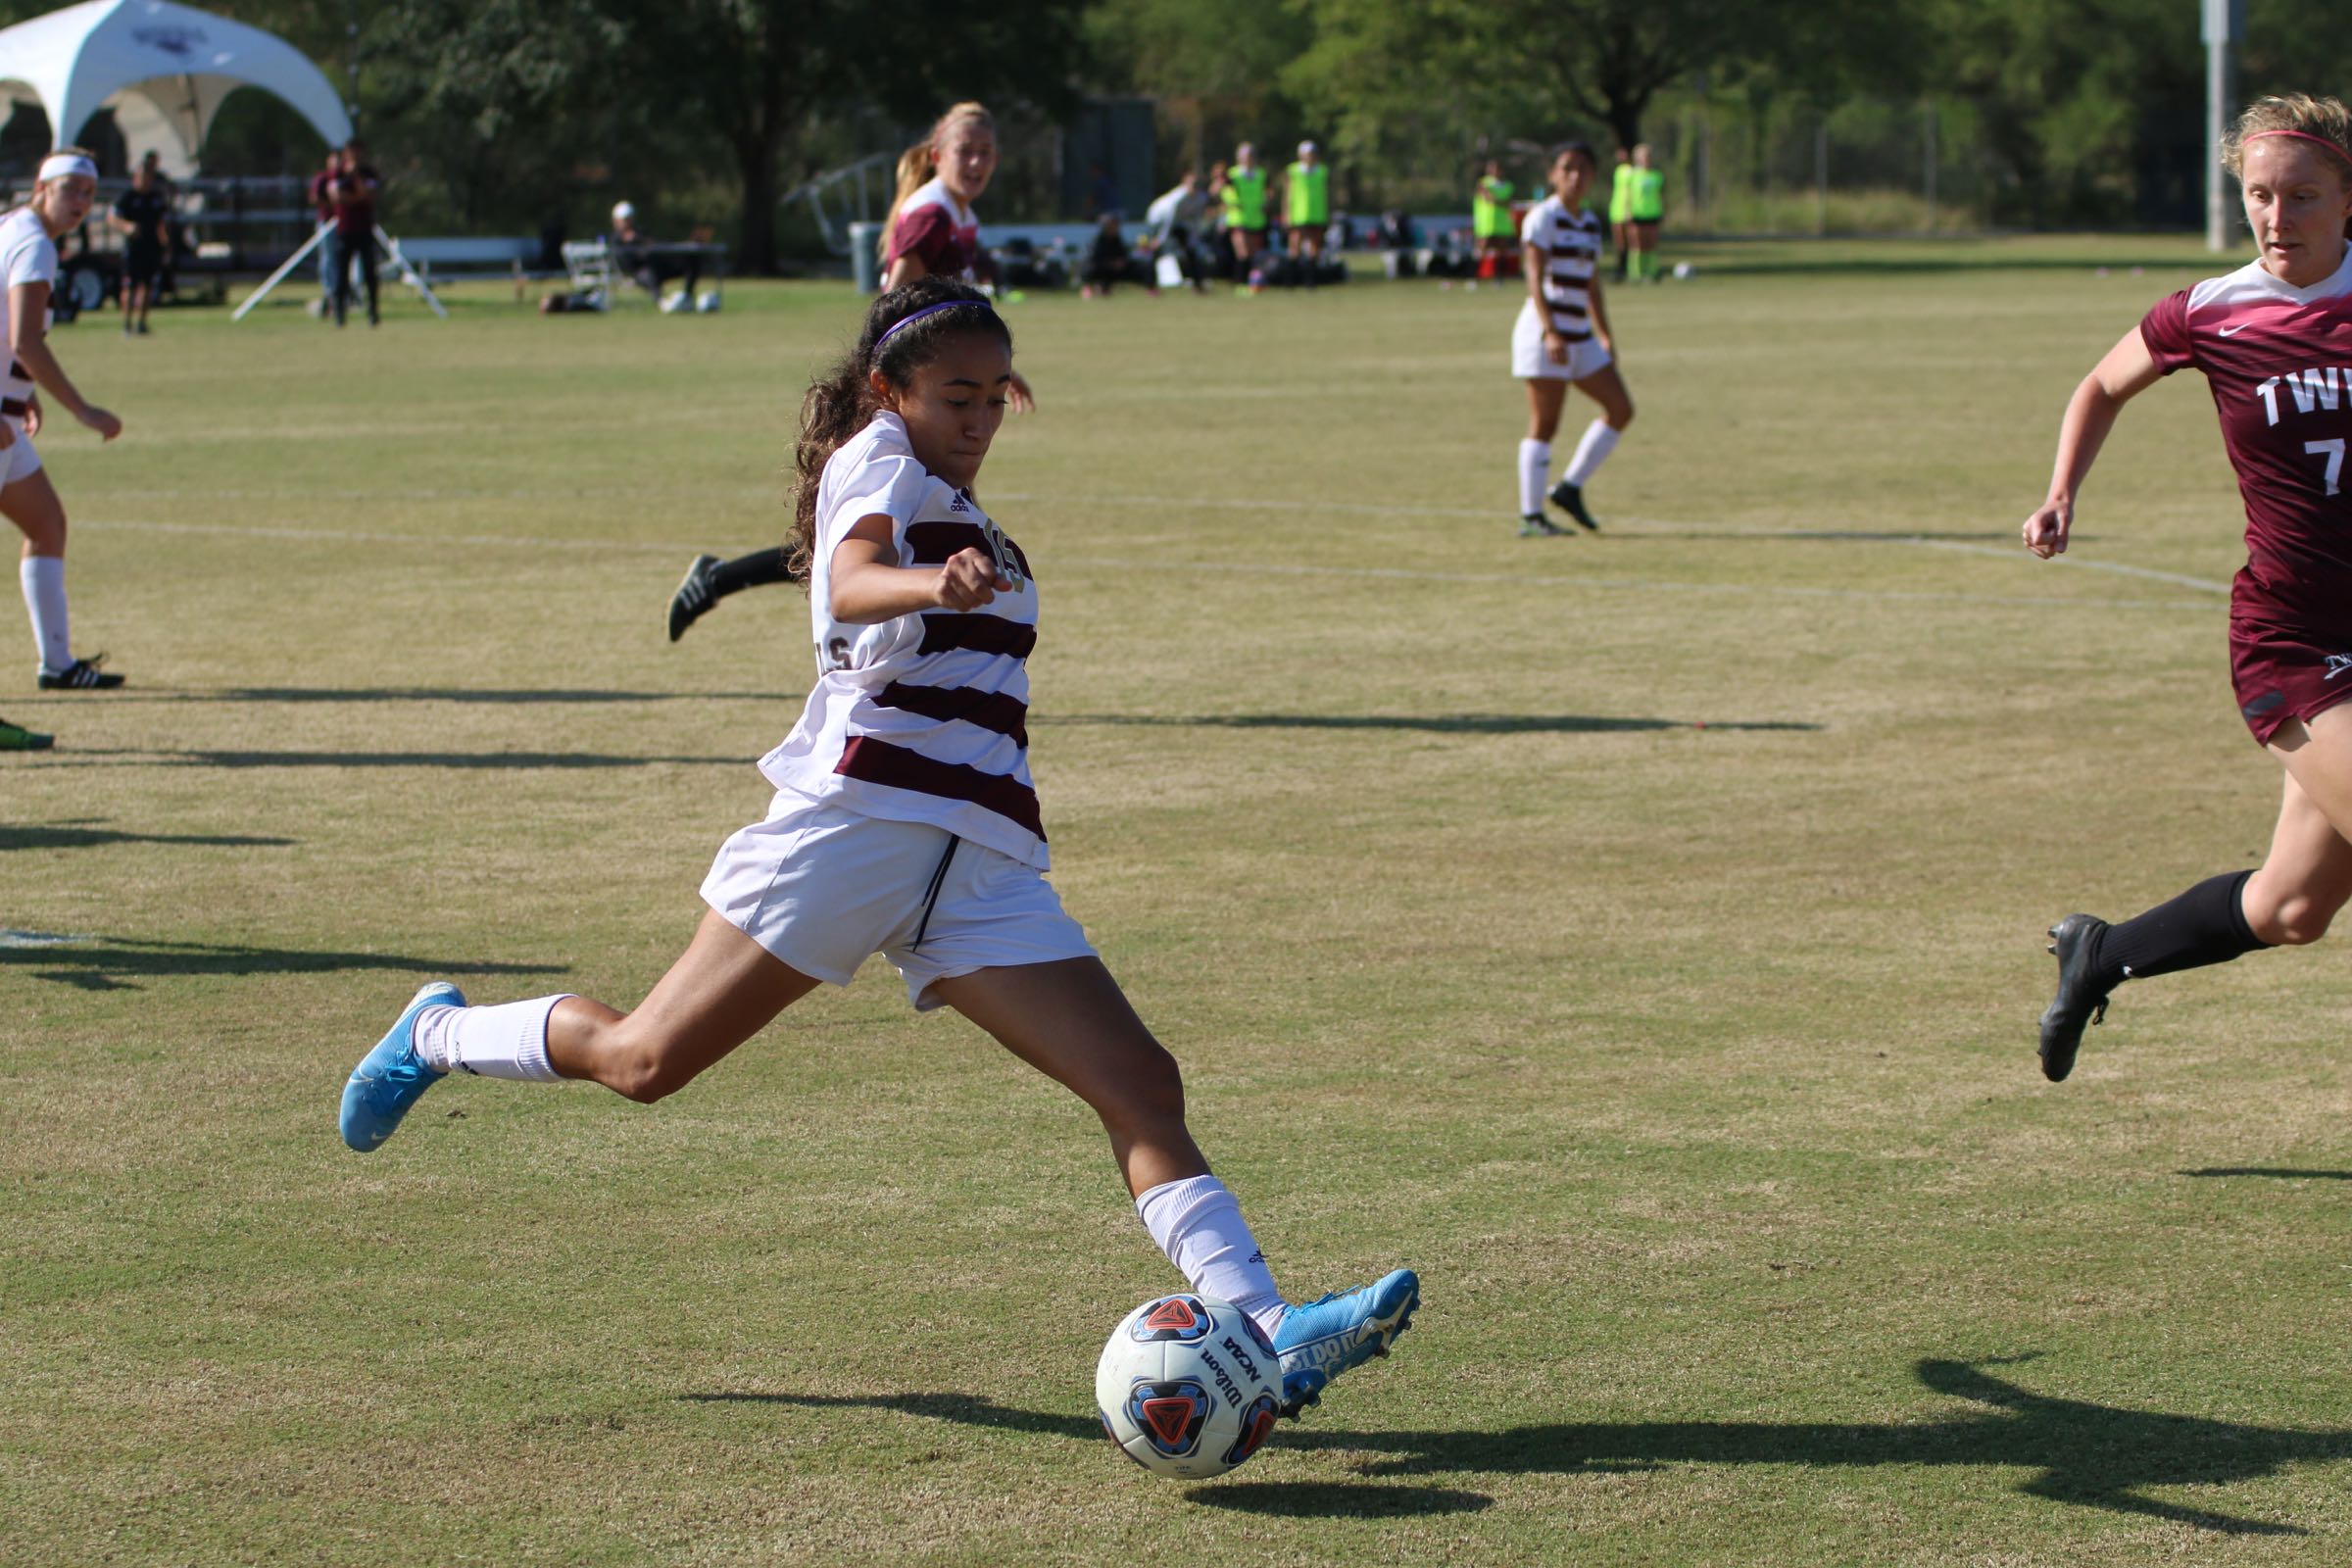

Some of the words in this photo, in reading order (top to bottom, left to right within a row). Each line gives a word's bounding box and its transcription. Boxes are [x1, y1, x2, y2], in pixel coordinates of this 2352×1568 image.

[2304, 438, 2346, 496] 7
[1223, 1337, 1261, 1383] NCAA
[1311, 1338, 1341, 1365] DO
[1200, 1348, 1243, 1408] Wilson
